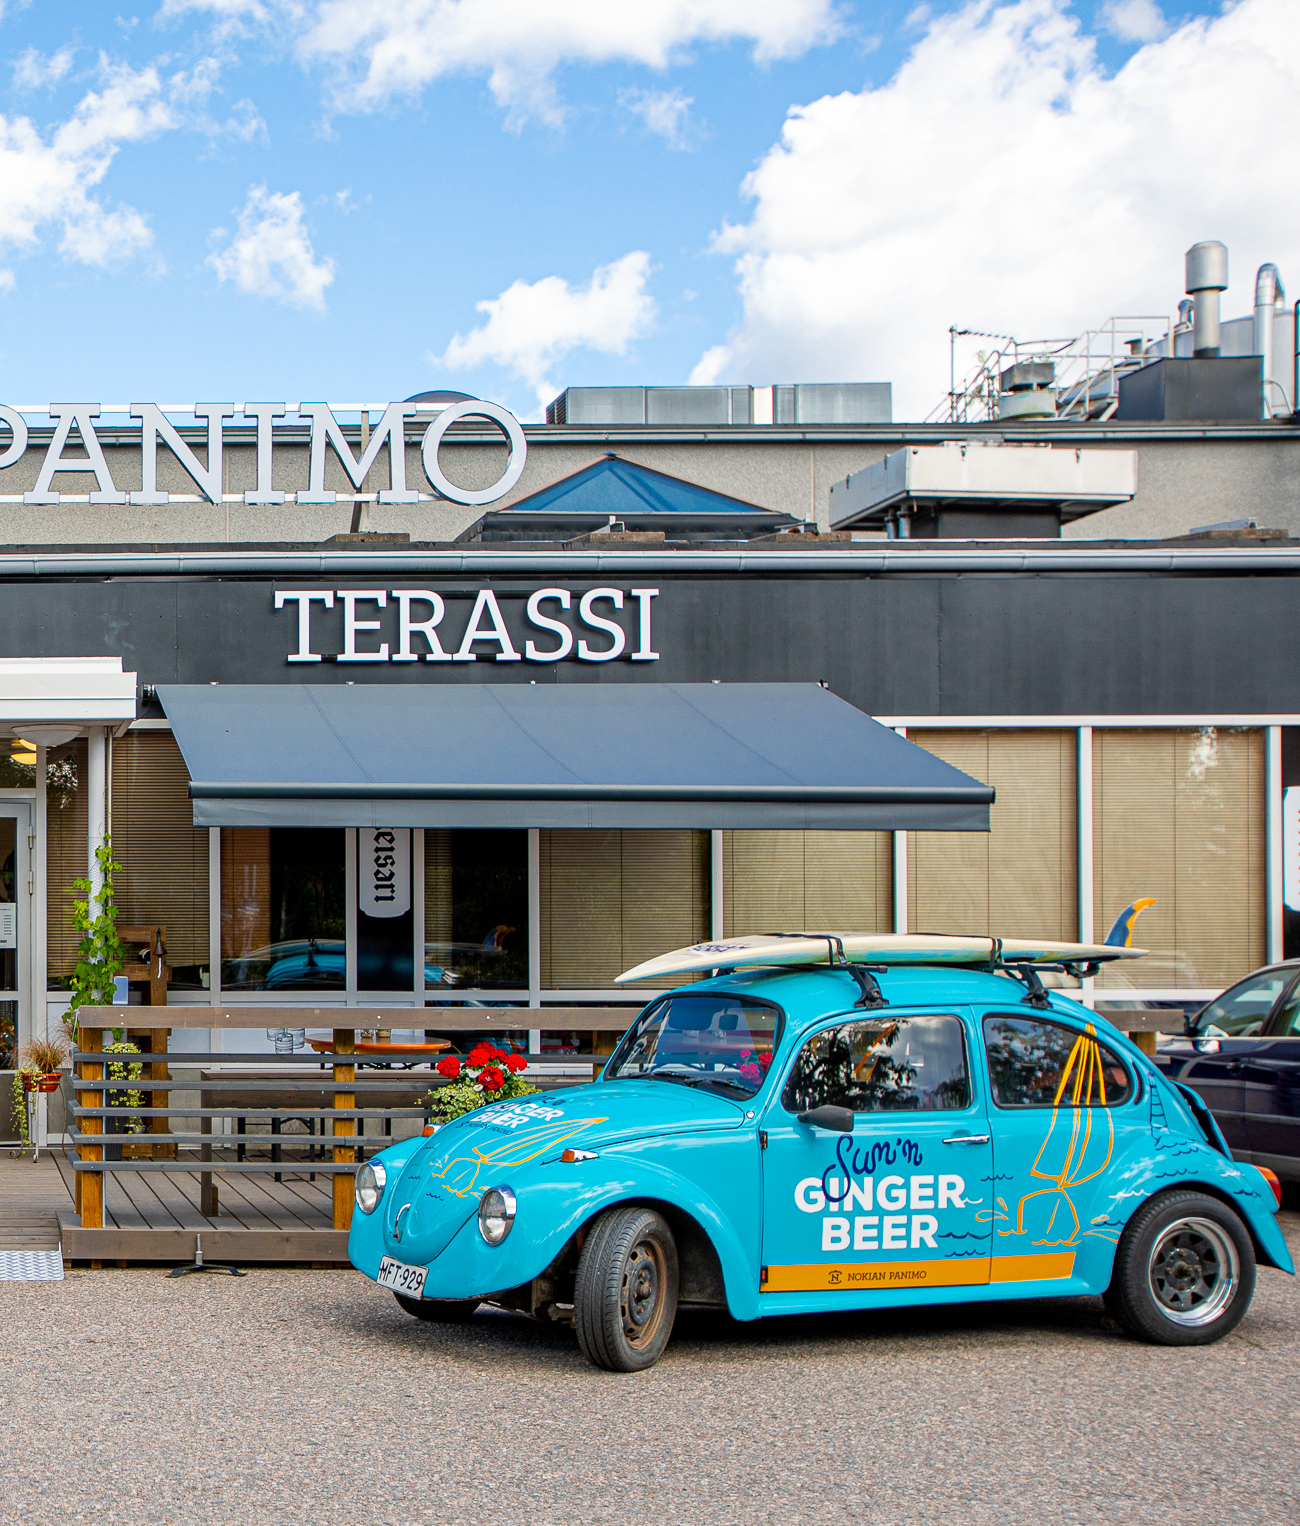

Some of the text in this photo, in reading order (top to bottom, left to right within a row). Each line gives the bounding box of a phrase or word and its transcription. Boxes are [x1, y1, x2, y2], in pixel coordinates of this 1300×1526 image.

[274, 587, 661, 664] TERASSI
[373, 828, 396, 903] eisari
[794, 1174, 967, 1214] GINGER
[822, 1134, 923, 1203] Sun'n
[821, 1214, 939, 1251] BEER
[847, 1271, 886, 1282] NOKIAN
[889, 1270, 927, 1280] PANIMO
